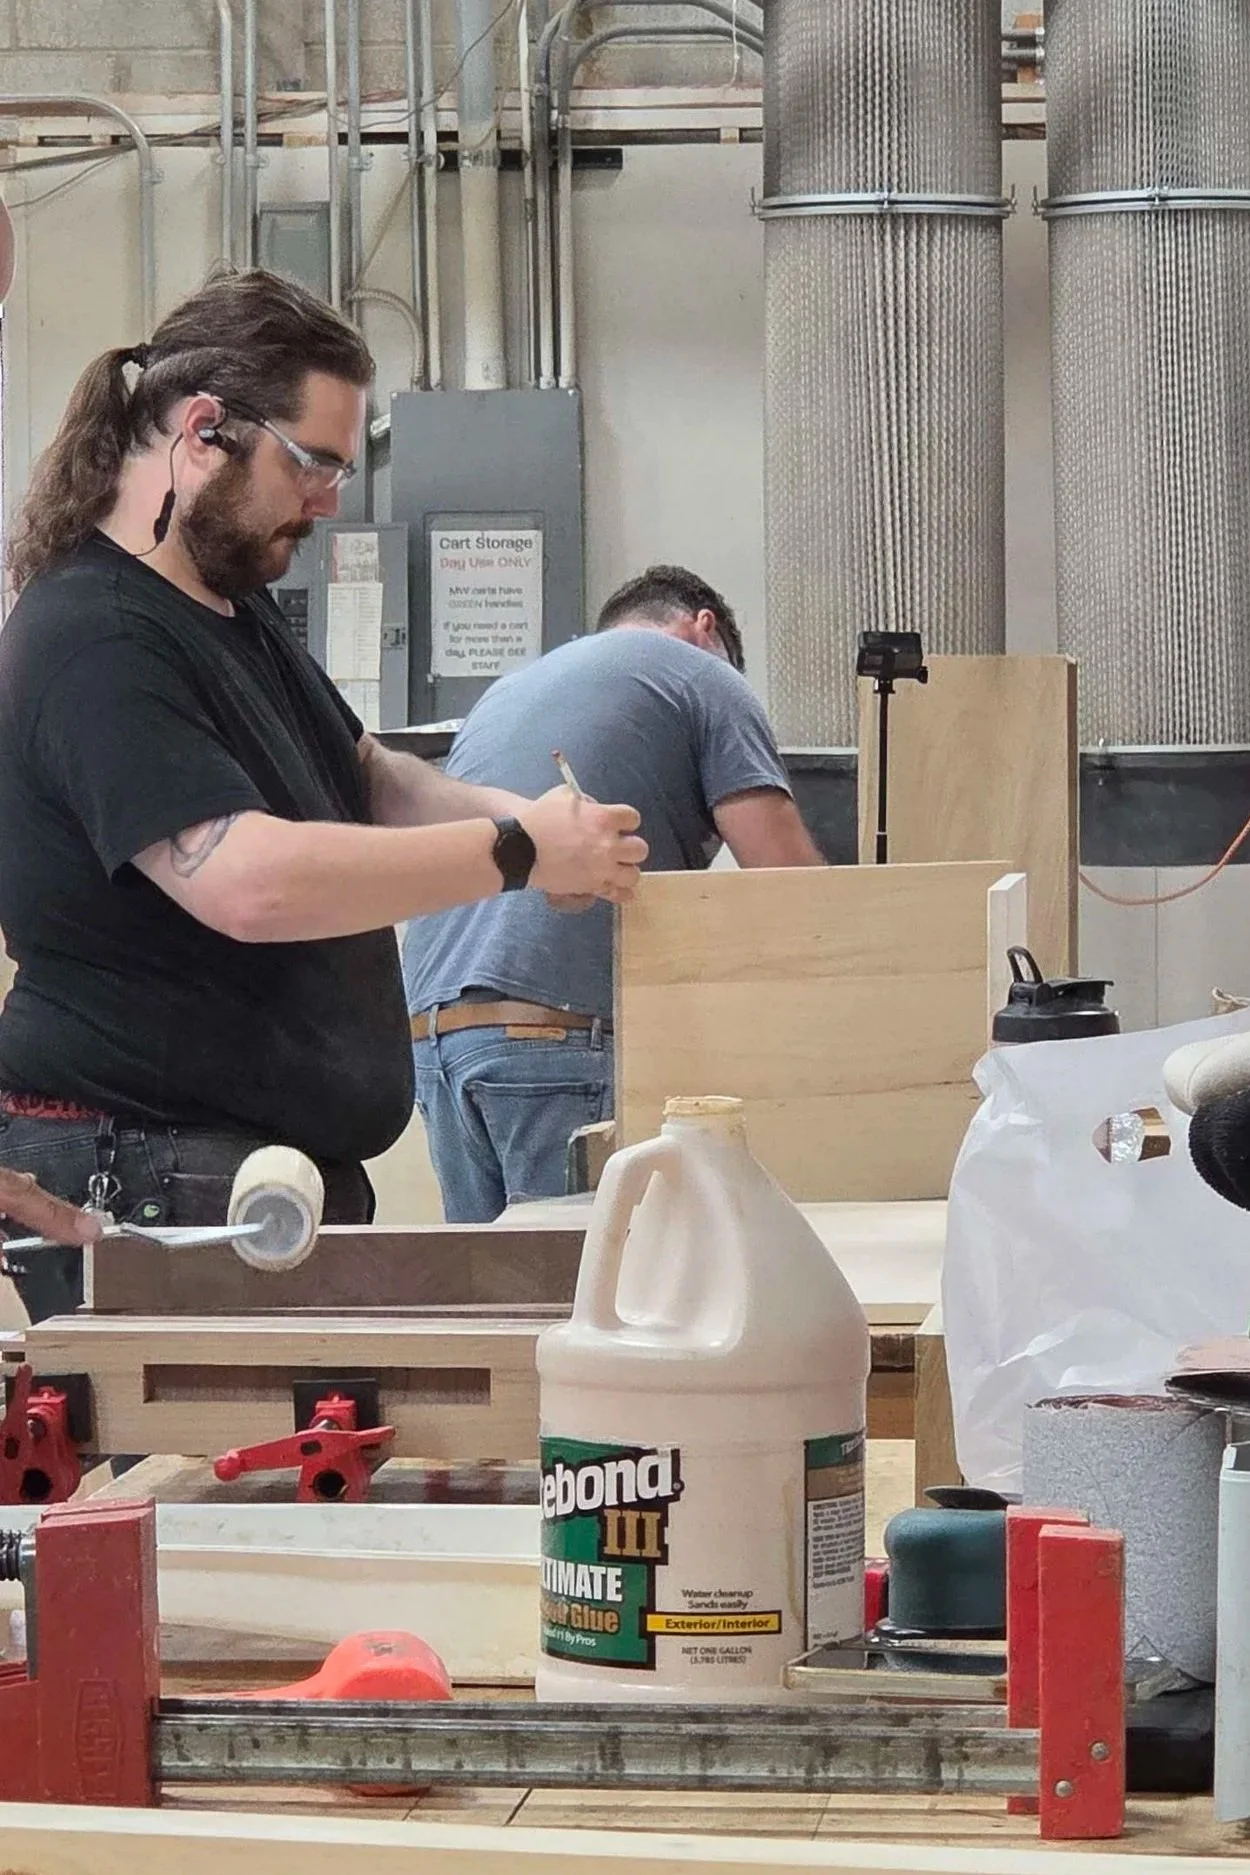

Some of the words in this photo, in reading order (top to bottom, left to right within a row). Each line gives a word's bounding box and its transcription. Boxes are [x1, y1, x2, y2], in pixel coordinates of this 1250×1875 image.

[440, 537, 471, 550] Cart
[476, 536, 533, 552] Storage
[440, 558, 466, 571] Day
[469, 557, 494, 568] Use
[498, 557, 532, 568] ONLY
[500, 586, 523, 595] have
[452, 623, 471, 632] you
[473, 622, 498, 630] need
[509, 622, 529, 630] cart
[449, 634, 462, 643] for
[491, 635, 514, 643] than
[468, 648, 504, 657] PLEASE
[472, 662, 499, 670] STAFF
[540, 1448, 674, 1518] ebond
[603, 1509, 661, 1557] III
[682, 1589, 712, 1598] Water
[714, 1588, 754, 1600] cleanup
[688, 1600, 718, 1609] Sands
[720, 1599, 749, 1610] easily
[570, 1603, 619, 1633] Glue
[665, 1617, 770, 1630] Exterior/Interior
[576, 1634, 597, 1646] Pros
[682, 1647, 698, 1655] NET
[700, 1647, 717, 1655] ONE
[719, 1646, 752, 1655] GALLON
